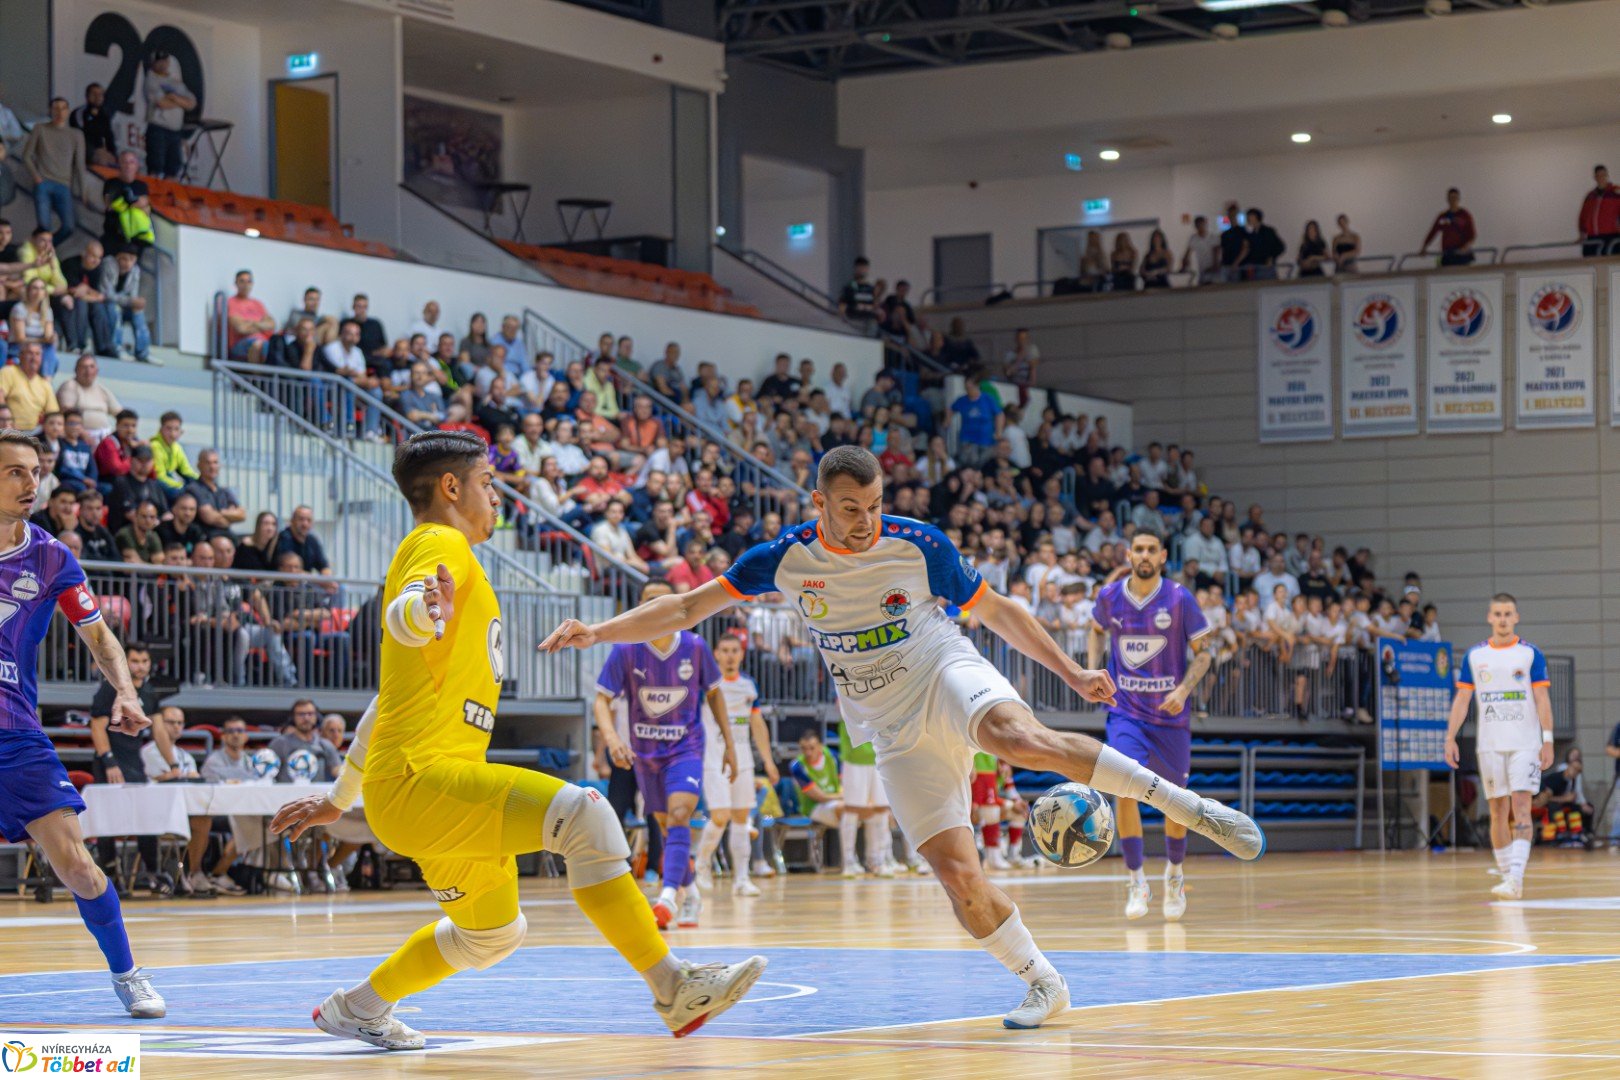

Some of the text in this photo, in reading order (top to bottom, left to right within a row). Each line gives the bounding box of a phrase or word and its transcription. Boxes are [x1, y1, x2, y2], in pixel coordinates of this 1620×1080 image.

[802, 579, 825, 589] JAKO
[970, 687, 991, 703] JAKO
[1145, 776, 1160, 800] JAKO
